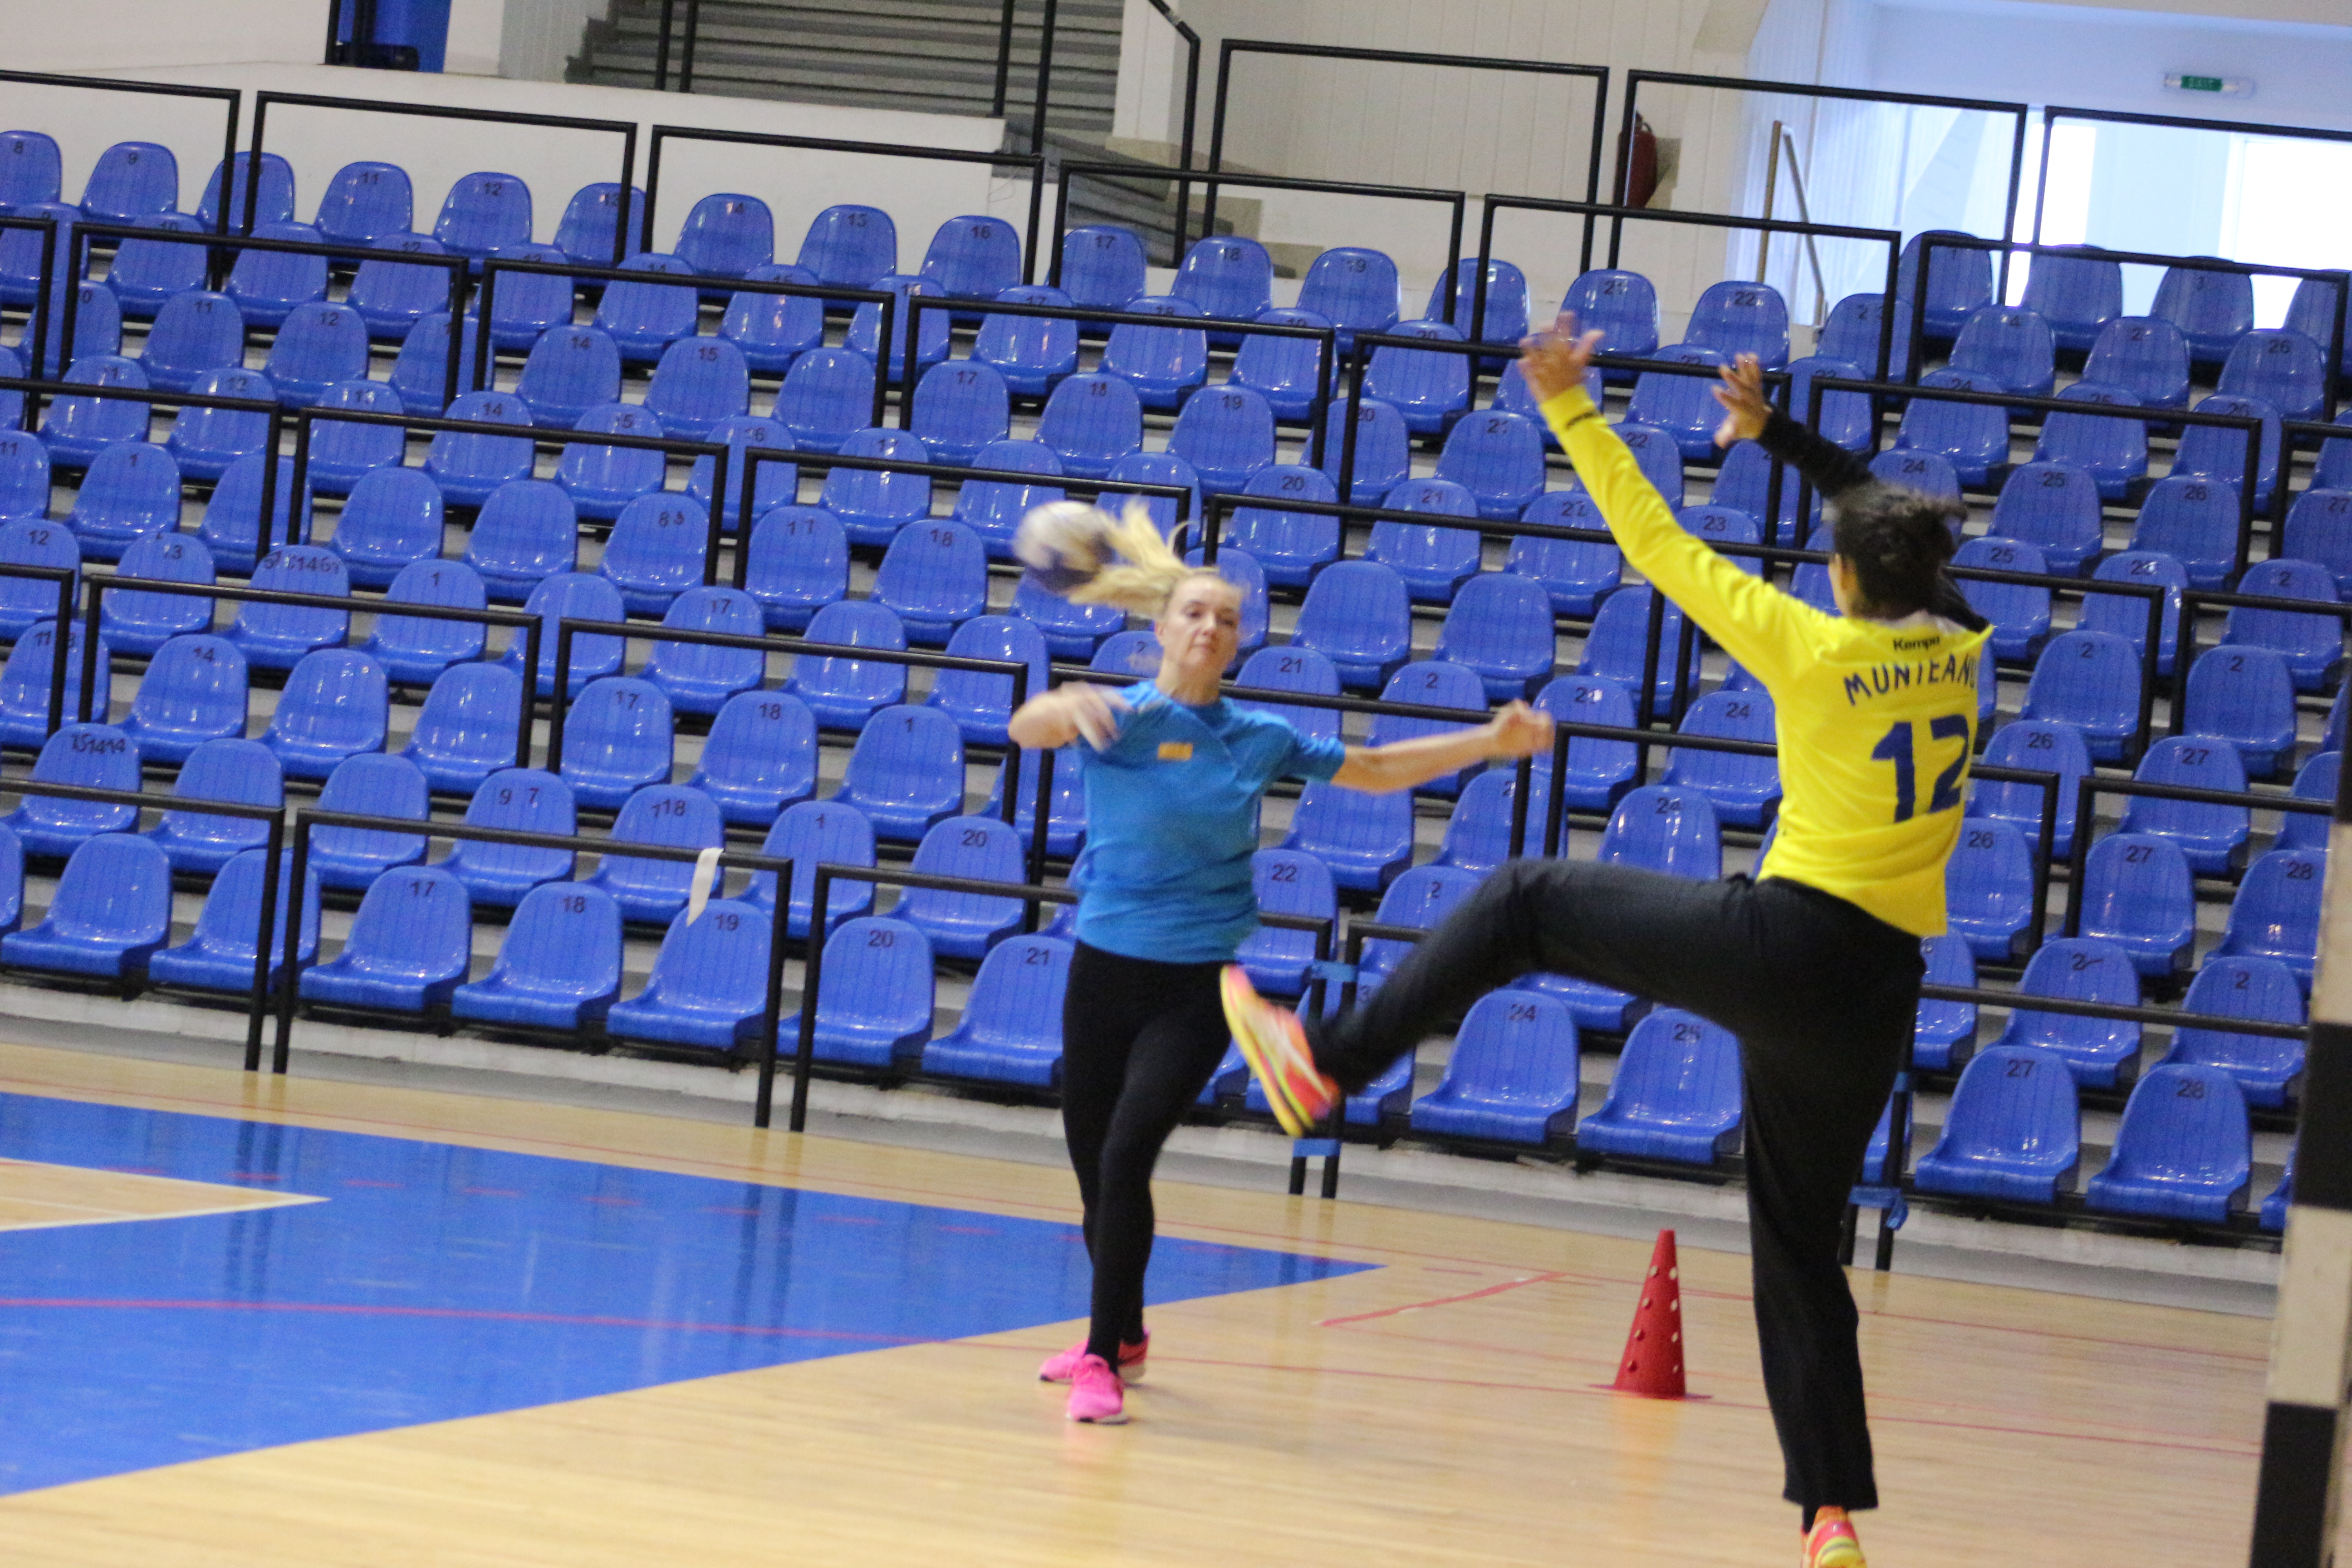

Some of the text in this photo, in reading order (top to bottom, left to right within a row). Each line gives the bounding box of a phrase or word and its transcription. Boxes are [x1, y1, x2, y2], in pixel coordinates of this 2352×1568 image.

[363, 173, 378, 183] 11
[485, 182, 501, 196] 12
[847, 213, 867, 227] 15
[970, 226, 991, 239] 16
[1095, 235, 1114, 249] 17
[1735, 291, 1755, 306] 22
[194, 300, 213, 313] 11
[321, 313, 338, 326] 12
[571, 337, 590, 349] 14
[699, 347, 719, 361] 15
[227, 377, 247, 392] 12
[956, 371, 978, 384] 17
[1090, 382, 1107, 396] 18
[482, 402, 502, 416] 14
[1222, 395, 1242, 409] 19
[1903, 460, 1925, 472] 24
[1282, 475, 1303, 490] 20
[2043, 472, 2065, 486] 25
[1422, 489, 1442, 503] 21
[1704, 515, 1726, 530] 23
[27, 529, 50, 545] 12
[932, 528, 952, 544] 18
[1990, 548, 2013, 563] 25
[710, 598, 732, 613] 17
[193, 647, 214, 661] 14
[1280, 657, 1303, 673] 21
[760, 704, 781, 720] 18
[1725, 702, 1750, 719] 24
[2028, 732, 2053, 749] 26
[2181, 749, 2209, 764] 27
[1871, 714, 1969, 823] 12
[963, 829, 987, 847] 20
[1969, 832, 1994, 848] 26
[2126, 845, 2154, 862] 27
[1272, 865, 1297, 882] 22
[2286, 862, 2312, 880] 28
[411, 881, 436, 897] 17
[562, 896, 586, 914] 18
[715, 914, 739, 931] 19
[868, 930, 894, 947] 20
[1026, 947, 1050, 966] 21
[2007, 1059, 2035, 1078] 27
